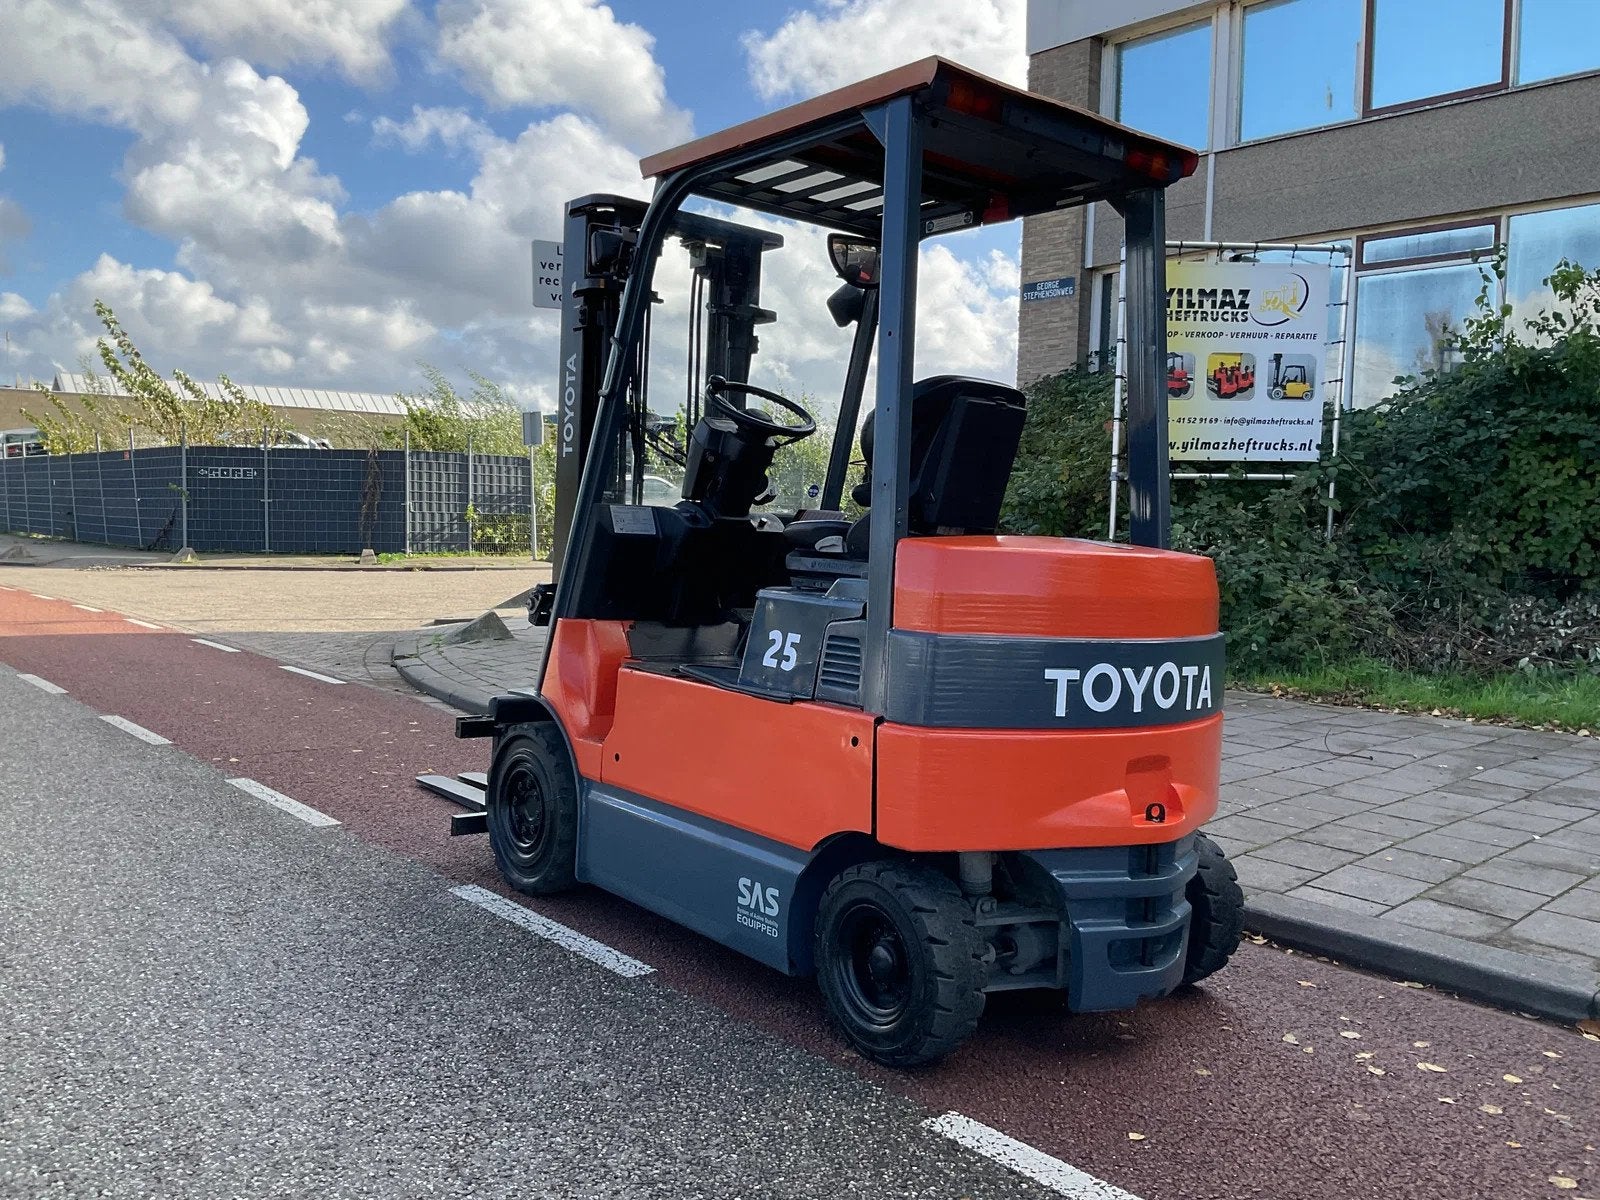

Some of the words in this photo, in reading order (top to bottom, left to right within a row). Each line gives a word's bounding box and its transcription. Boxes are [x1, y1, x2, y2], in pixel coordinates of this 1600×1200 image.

[540, 261, 562, 271] ver
[539, 276, 560, 286] rec
[1036, 280, 1060, 291] GEORGE
[1023, 286, 1074, 301] STEPHENSONWEG
[1165, 287, 1250, 310] YILMAZ
[1185, 331, 1224, 339] VERKOOP
[1230, 331, 1269, 340] VERHUUR
[1274, 332, 1318, 341] REPARATIE
[562, 352, 577, 458] TOYOTA
[1223, 416, 1314, 427] info@yilmazheftrucks.nl
[762, 629, 802, 672] 25
[1044, 661, 1212, 718] TOYOTA
[737, 876, 780, 917] SAS
[736, 913, 779, 938] EQUIPPED
